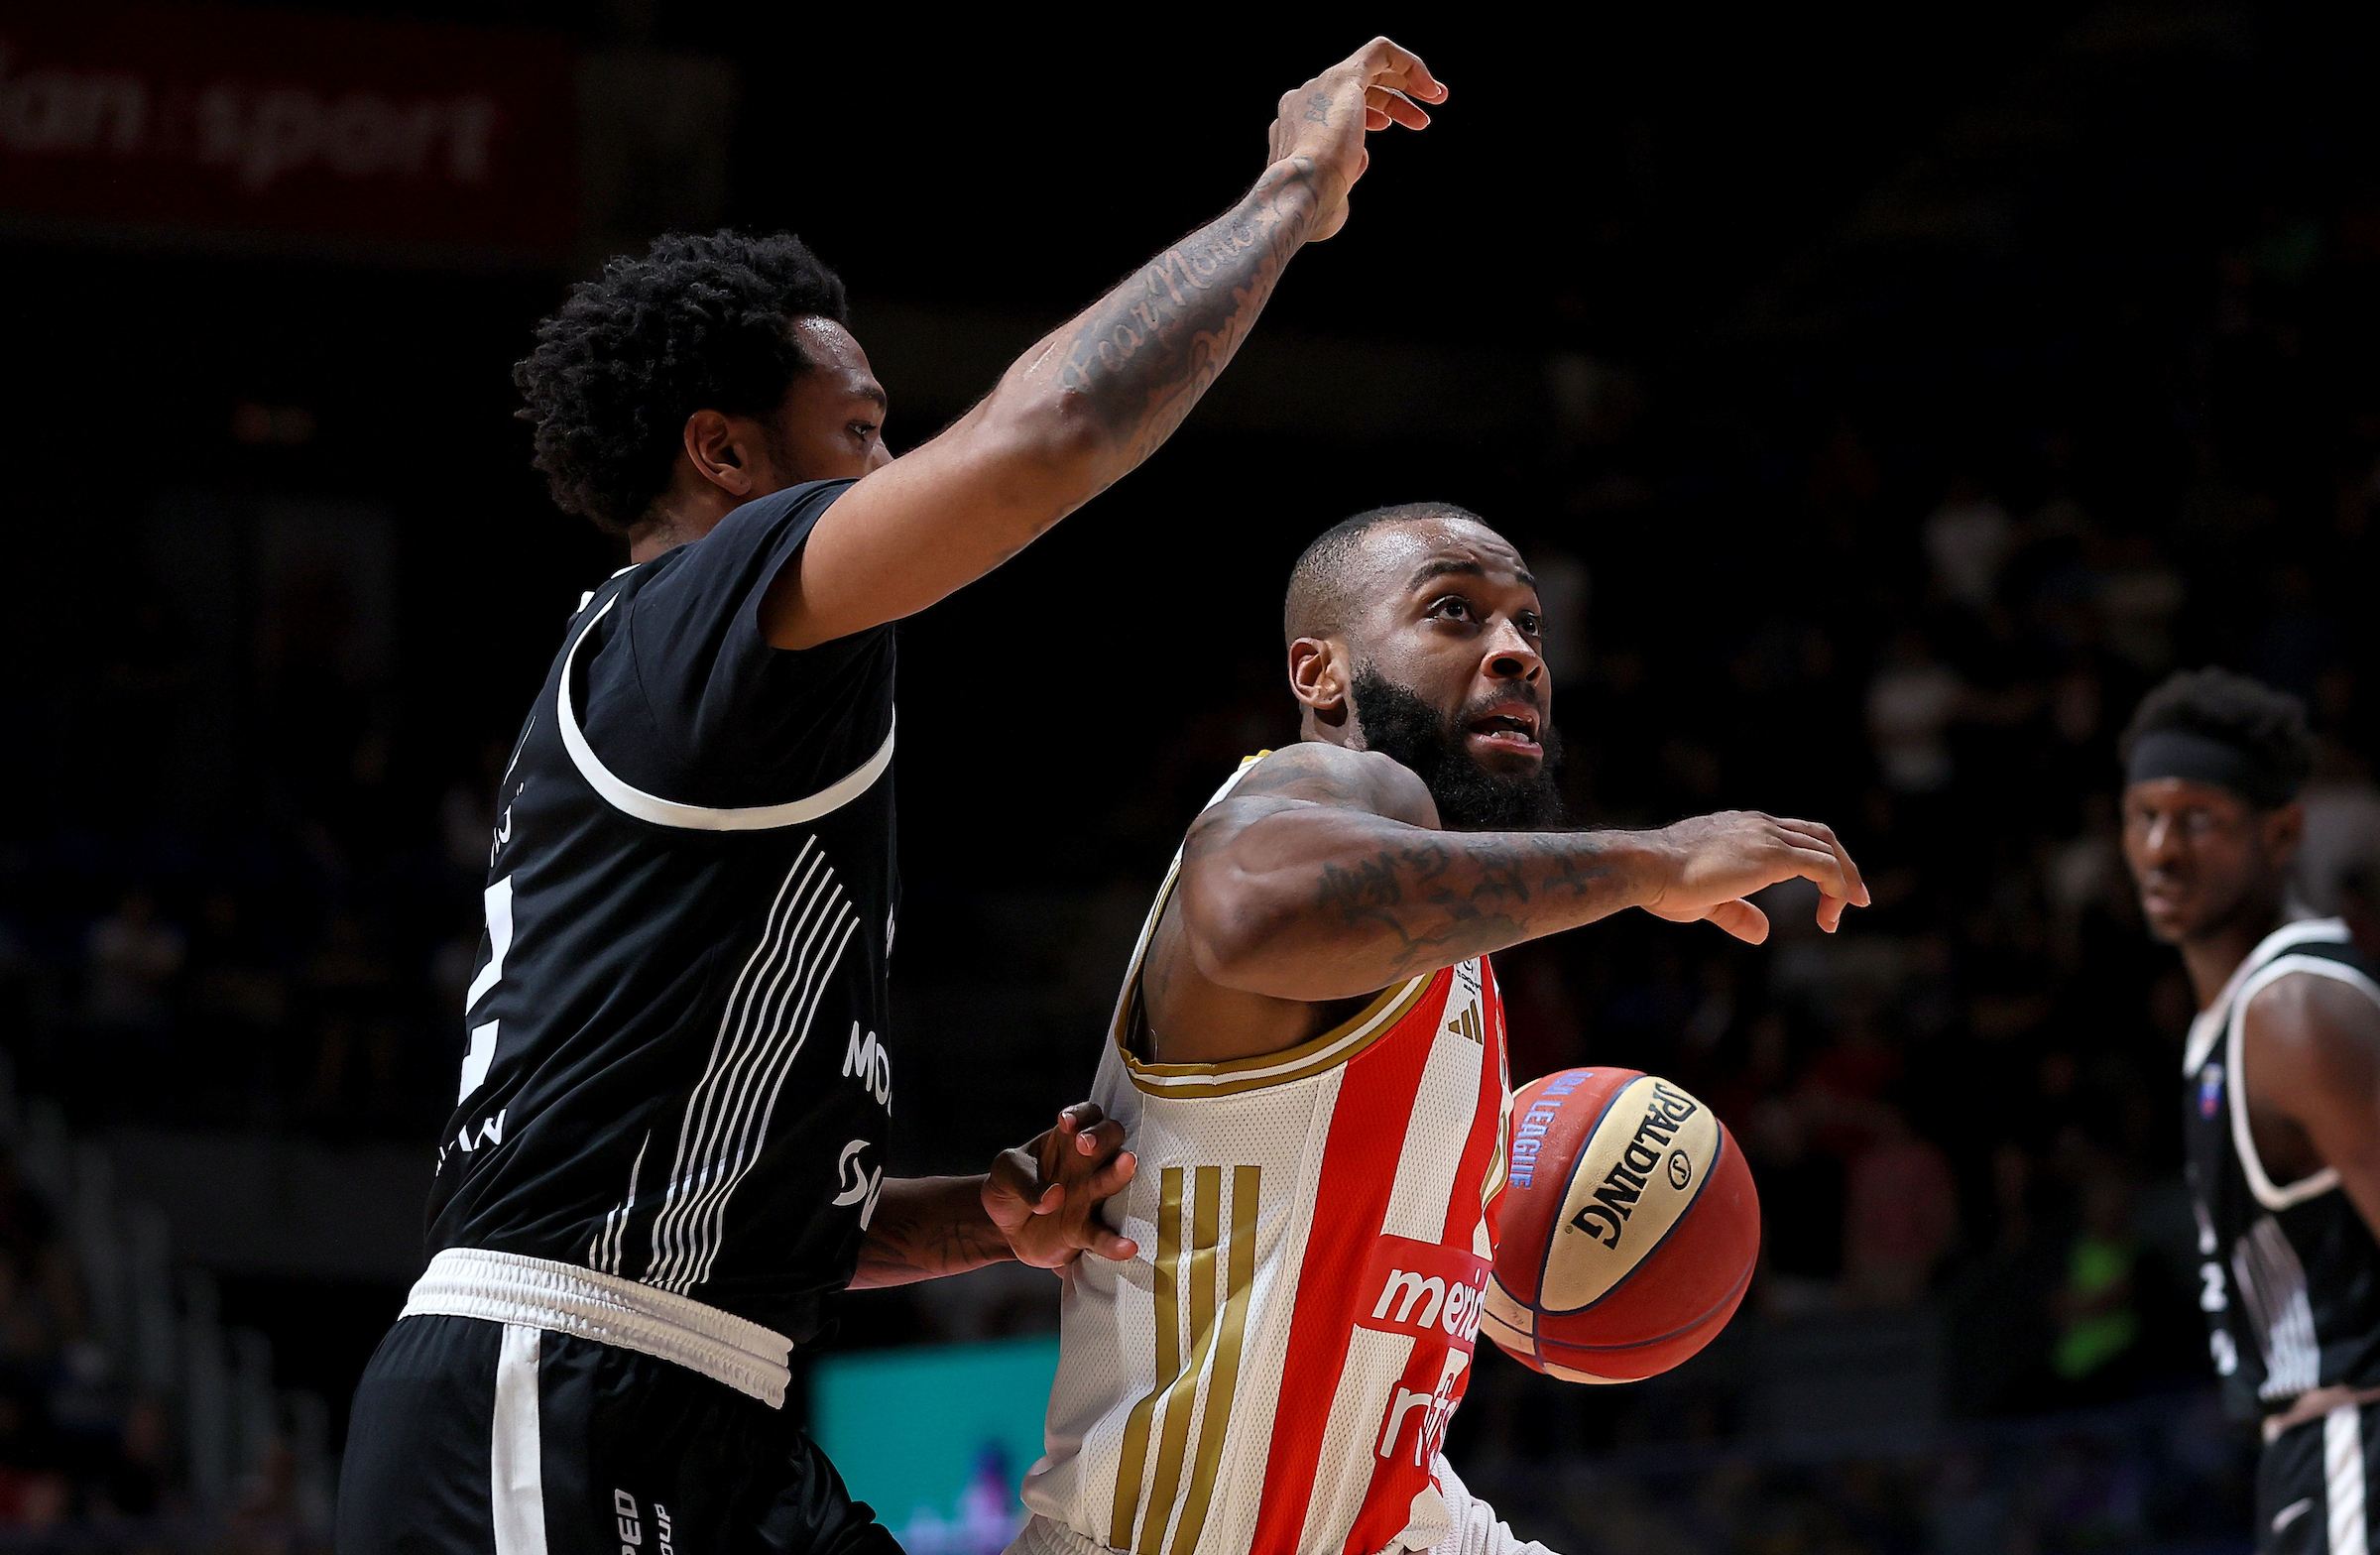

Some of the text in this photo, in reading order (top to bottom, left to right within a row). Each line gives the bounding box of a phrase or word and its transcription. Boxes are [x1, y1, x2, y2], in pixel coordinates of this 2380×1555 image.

[200, 81, 498, 194] sport
[1059, 292, 1161, 389] Fear
[843, 1020, 892, 1117] MO
[1571, 1081, 1697, 1251] SPALDING
